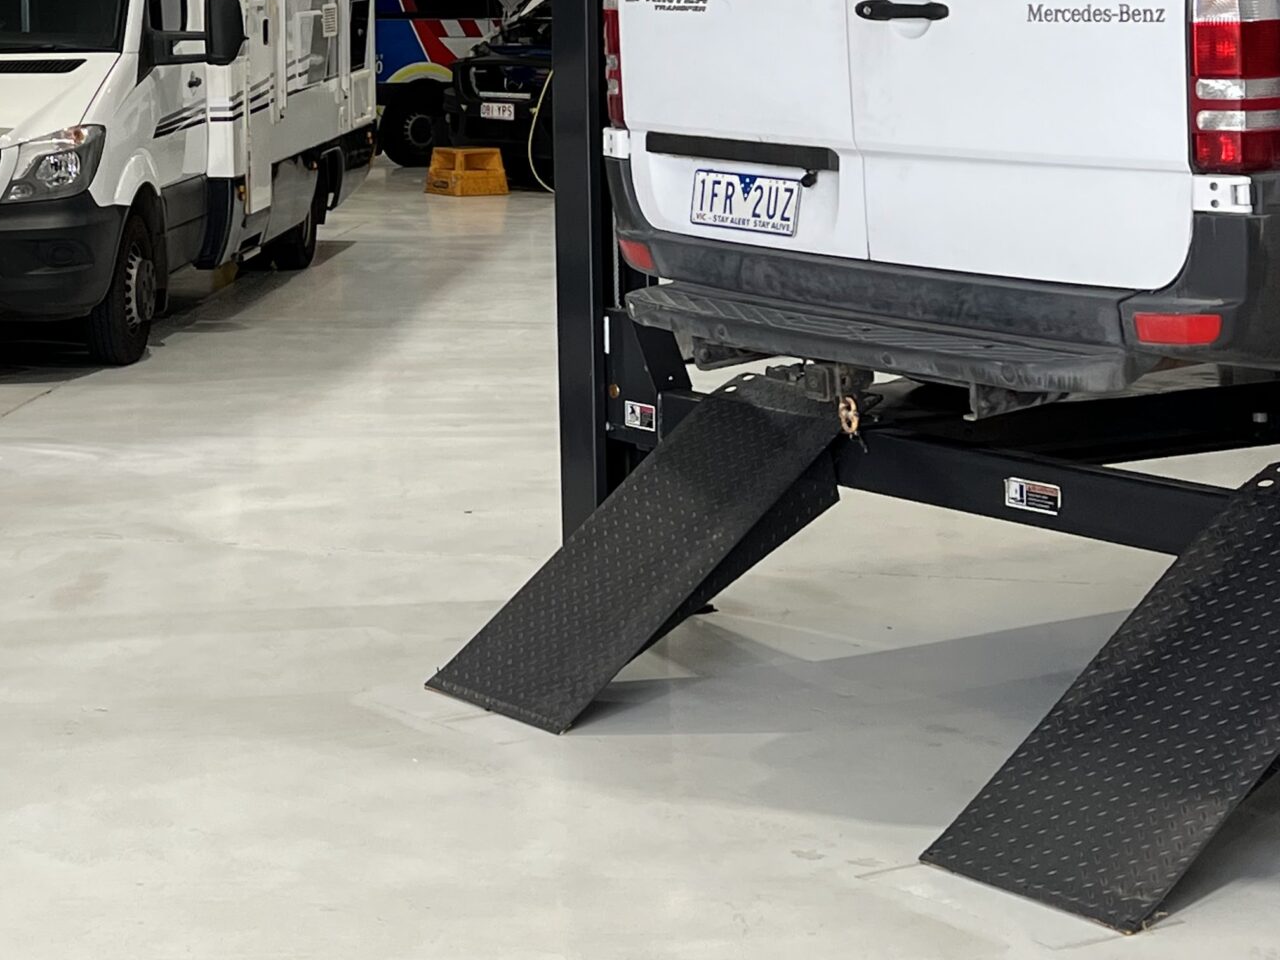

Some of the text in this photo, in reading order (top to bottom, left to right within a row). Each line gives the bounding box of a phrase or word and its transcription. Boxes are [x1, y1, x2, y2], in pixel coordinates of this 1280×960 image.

[1027, 3, 1166, 23] Mercedes-Benz
[496, 104, 512, 117] YPS
[700, 178, 794, 222] 1FR 2UZ
[696, 213, 706, 221] VIC
[713, 214, 729, 223] STAY
[730, 217, 750, 226] ALERT
[753, 219, 770, 228] STAY
[771, 222, 790, 232] ALIVE
